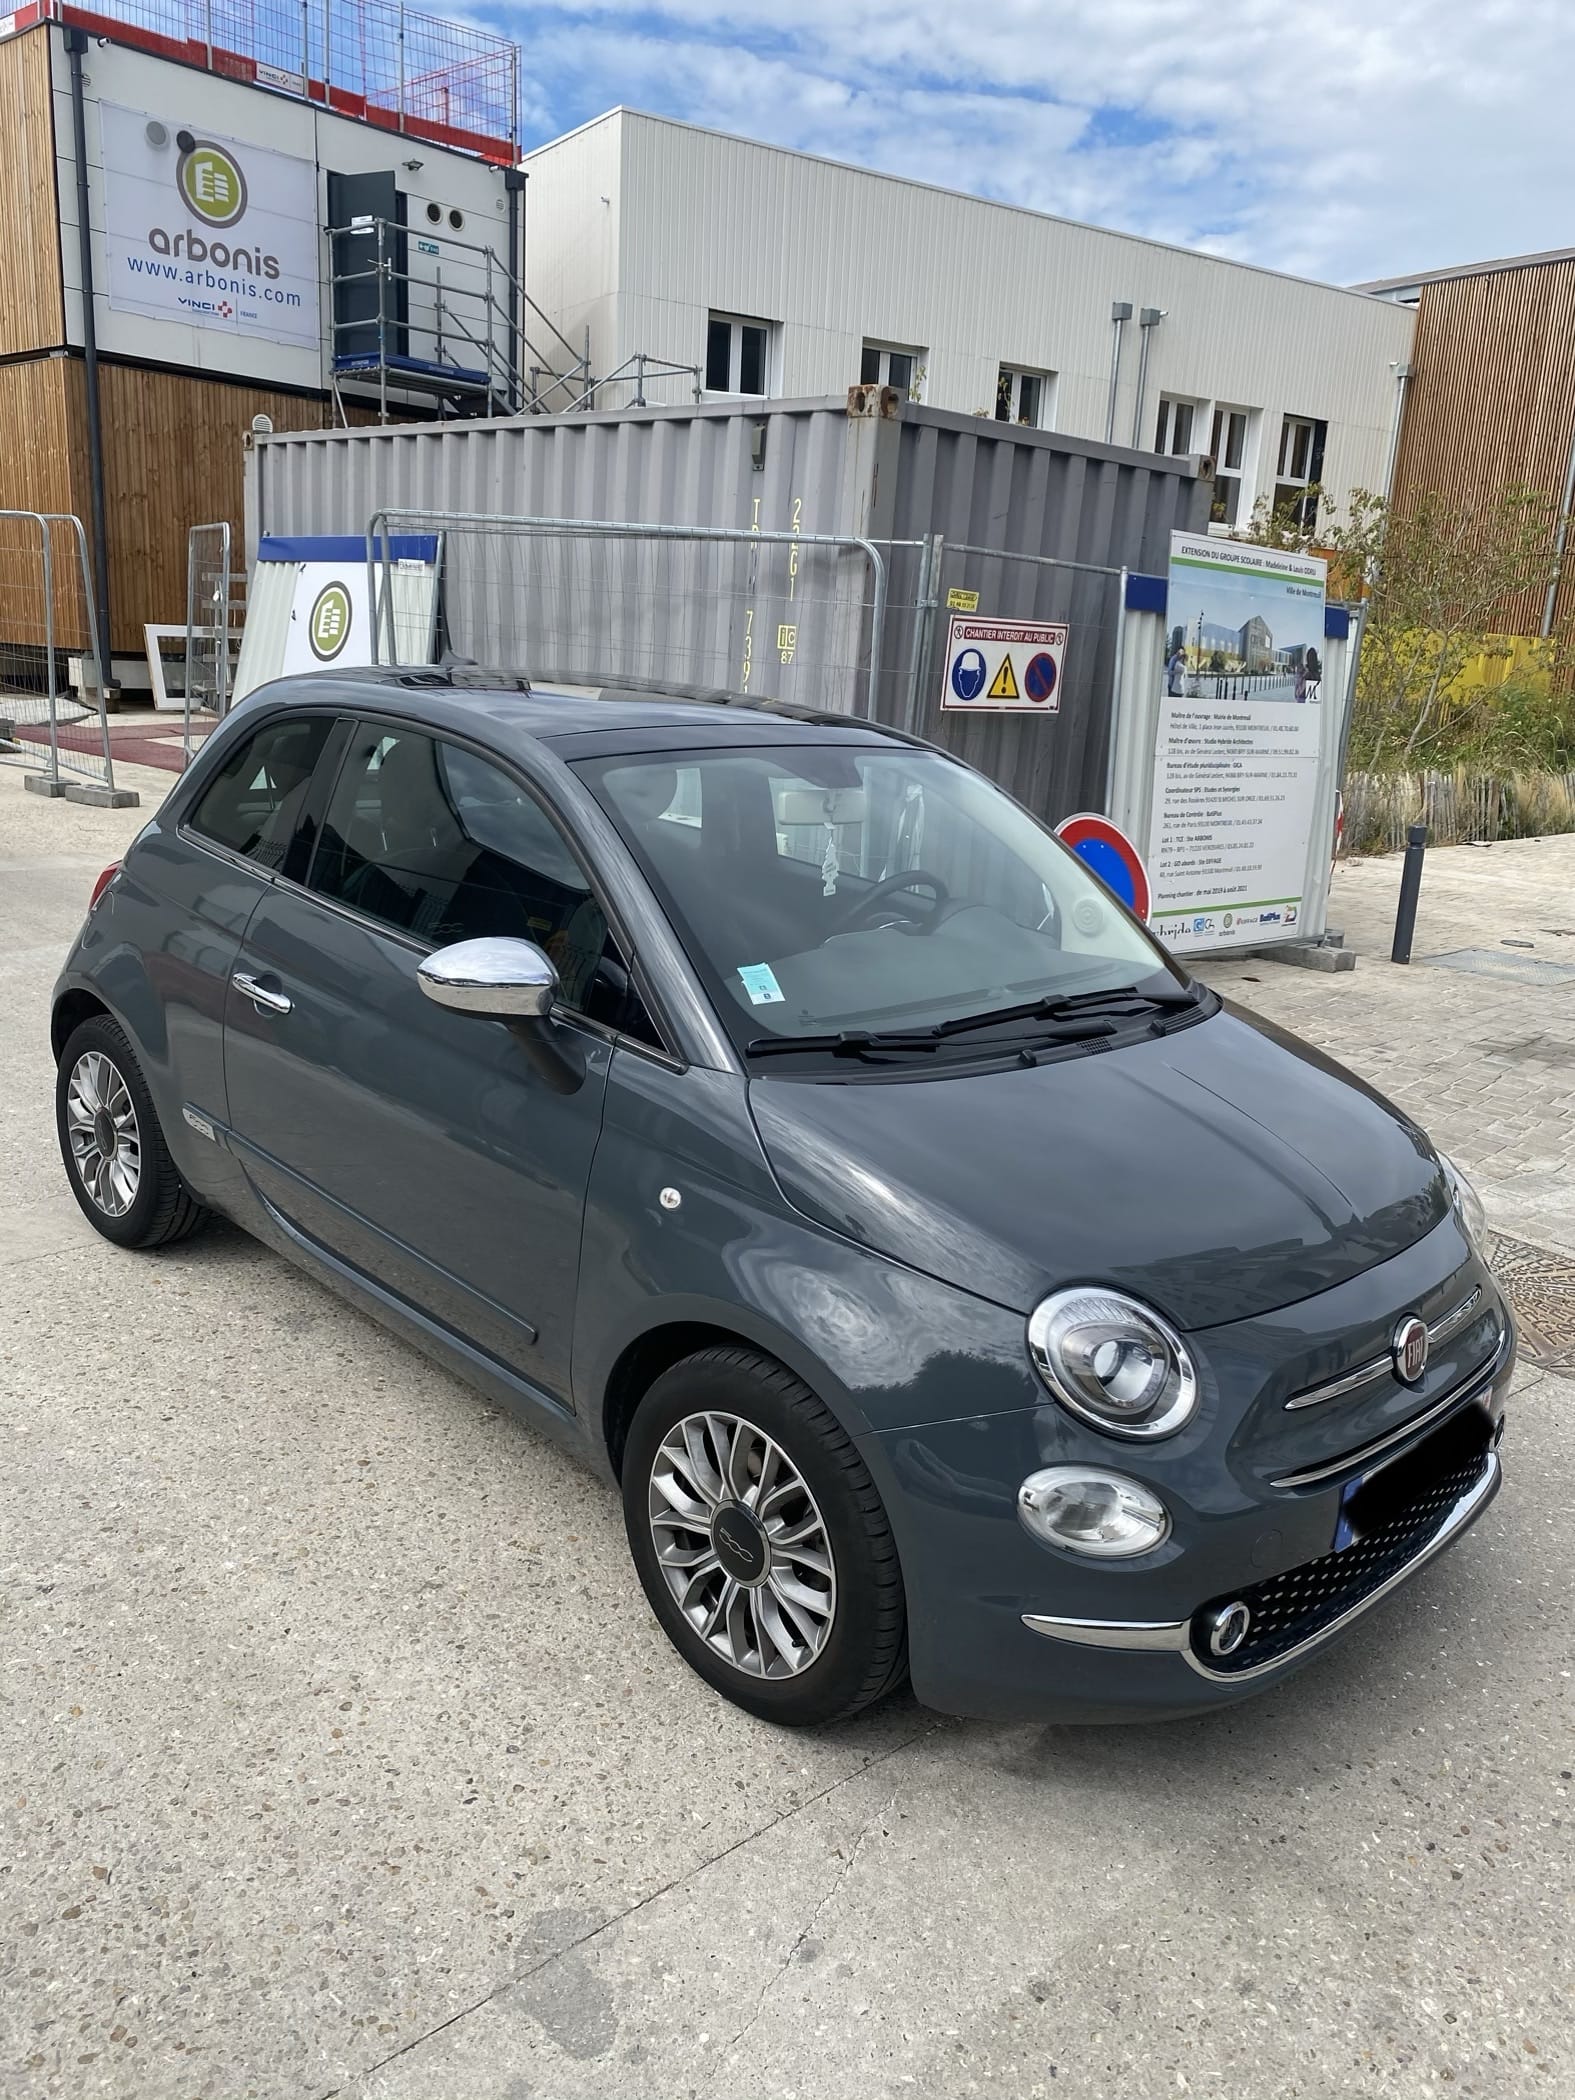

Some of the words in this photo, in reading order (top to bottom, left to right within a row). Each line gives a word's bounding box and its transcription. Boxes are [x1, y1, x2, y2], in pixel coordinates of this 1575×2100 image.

[148, 228, 280, 280] arbonis
[127, 257, 301, 307] www.arbonis.com
[178, 297, 216, 311] VINCI
[1181, 546, 1211, 558] EXTENSION
[1211, 551, 1219, 559] DU
[1220, 552, 1240, 563] GROUPE
[1286, 586, 1295, 594] Ville
[965, 628, 997, 639] CHANTIER
[997, 630, 1024, 641] INTERDIT
[1024, 632, 1033, 641] AU
[1033, 633, 1054, 643] PUBLIC
[781, 651, 794, 664] 87
[1408, 1335, 1423, 1368] FIAT
